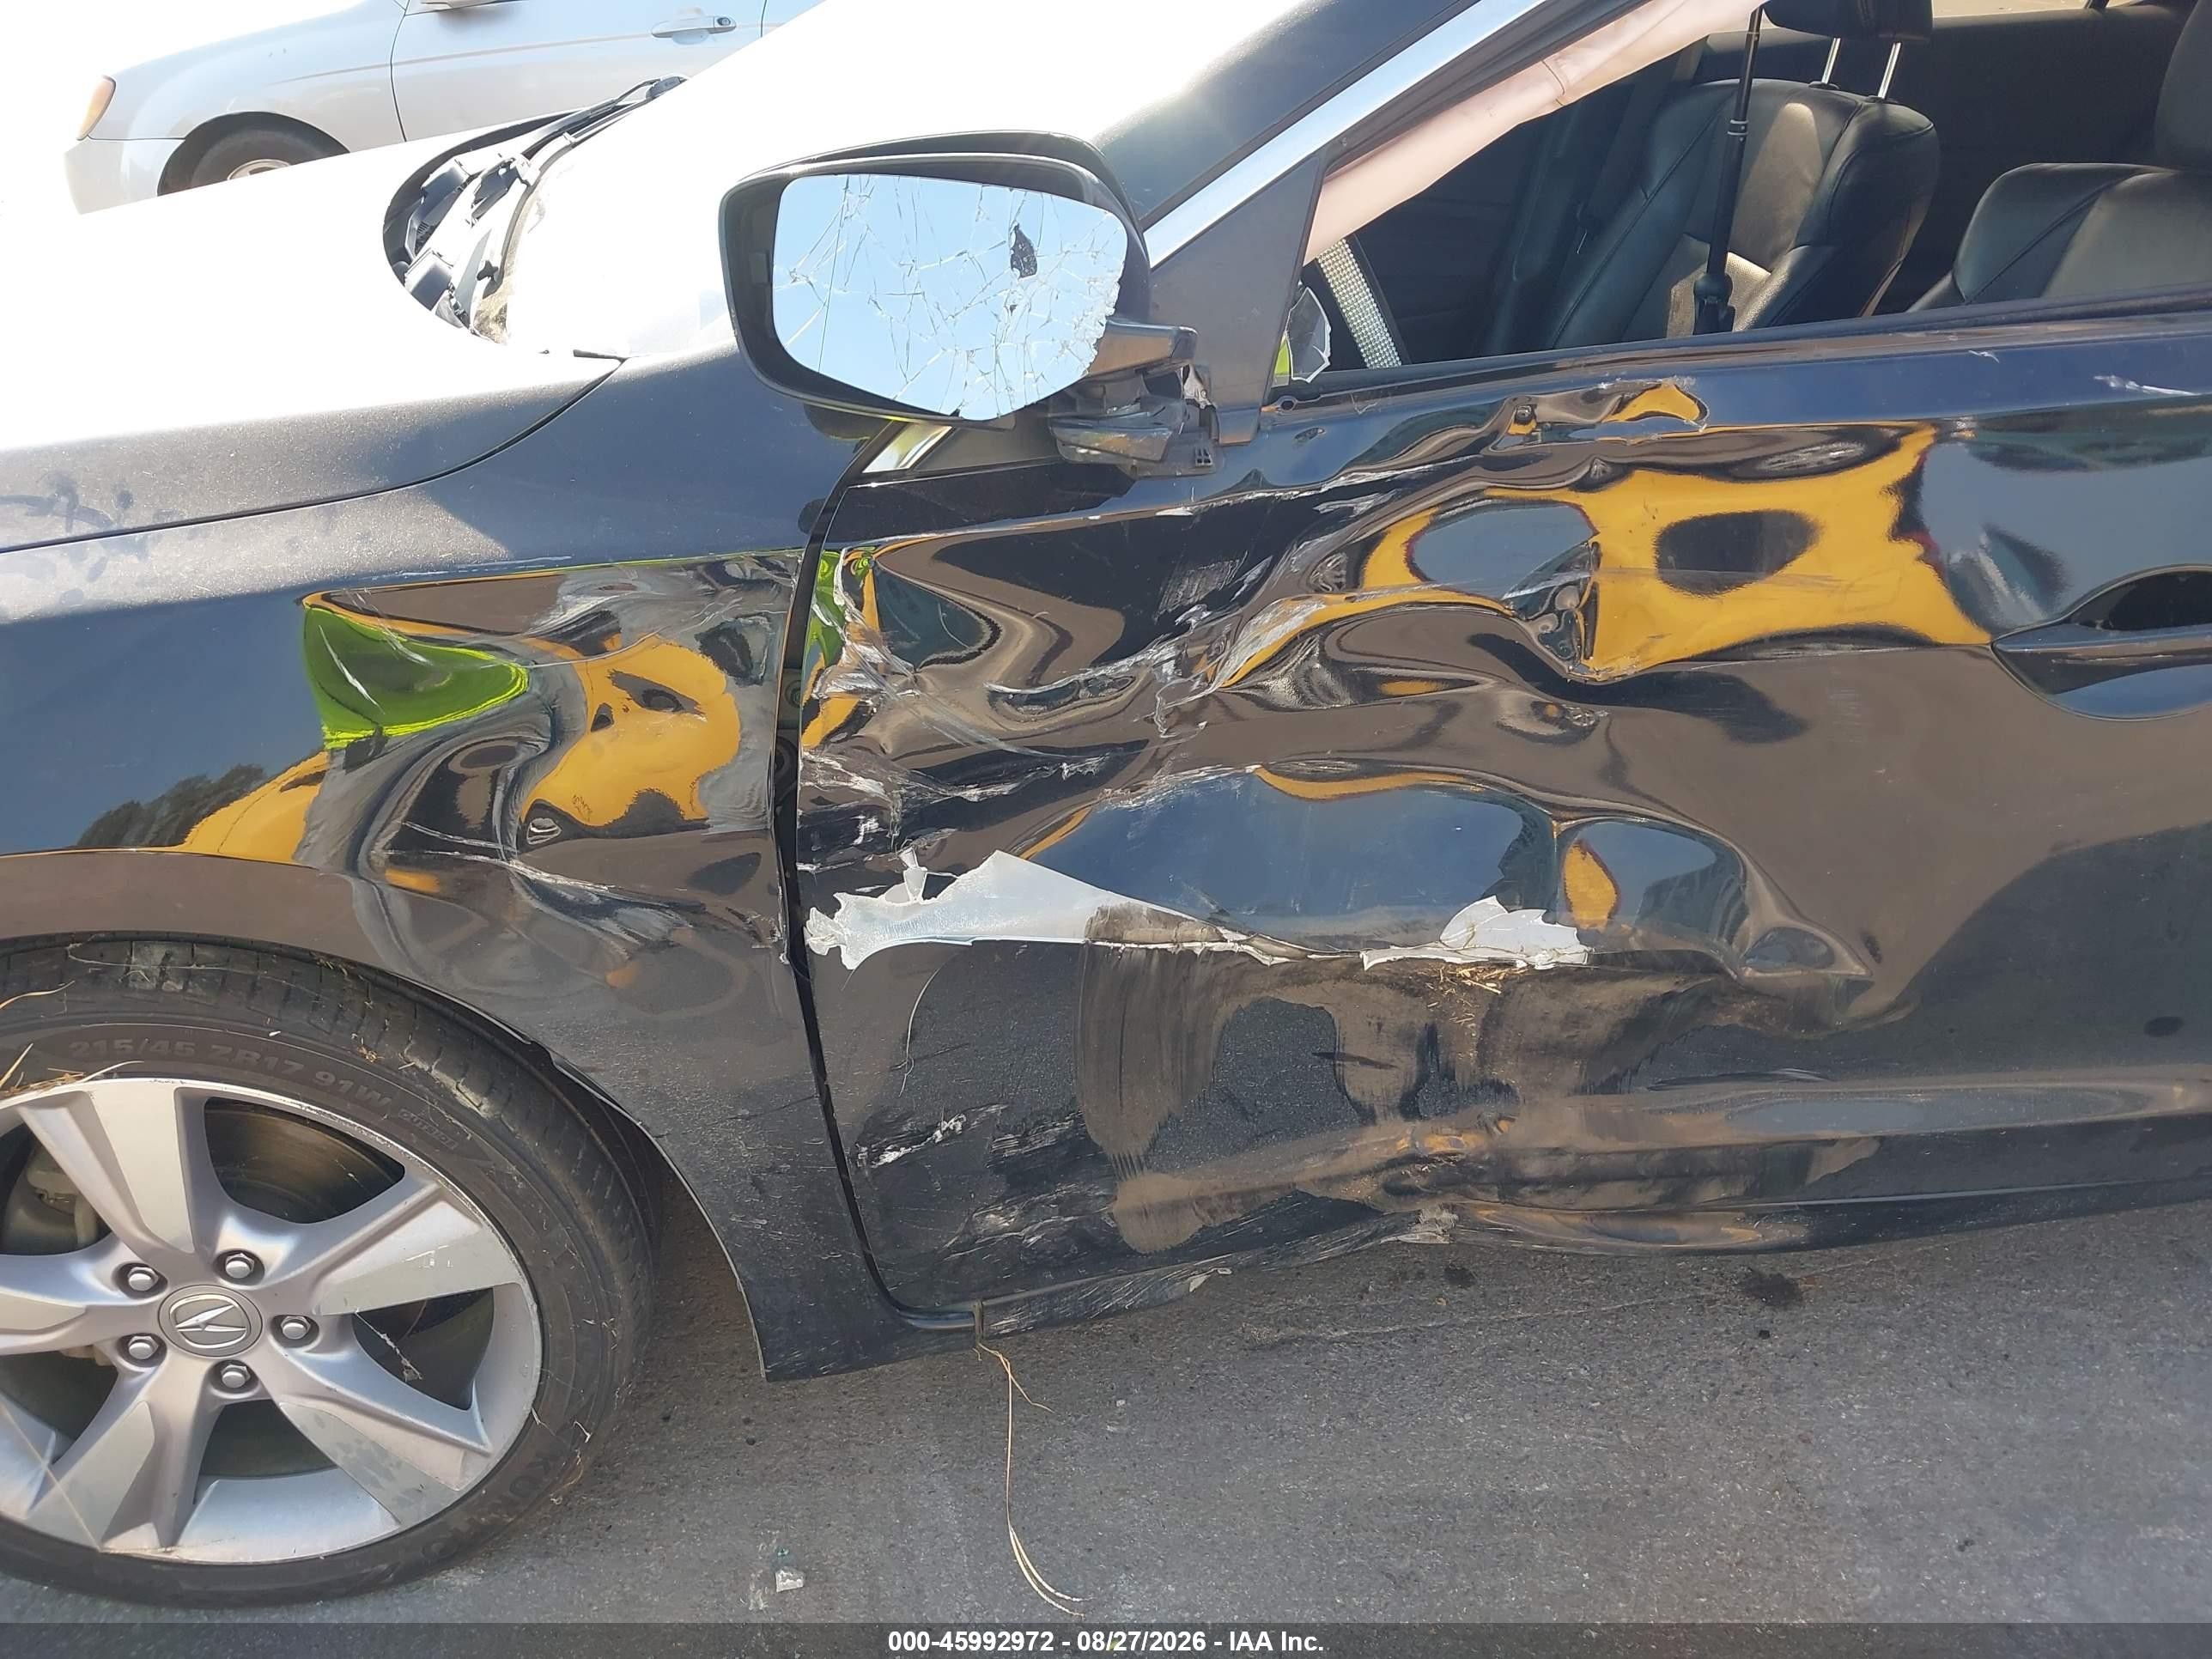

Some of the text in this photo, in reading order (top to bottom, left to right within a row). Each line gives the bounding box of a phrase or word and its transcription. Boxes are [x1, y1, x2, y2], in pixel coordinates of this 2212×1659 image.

[68, 1037, 197, 1060] 215/45
[208, 1044, 305, 1075] ZR17
[312, 1071, 393, 1109] 91W
